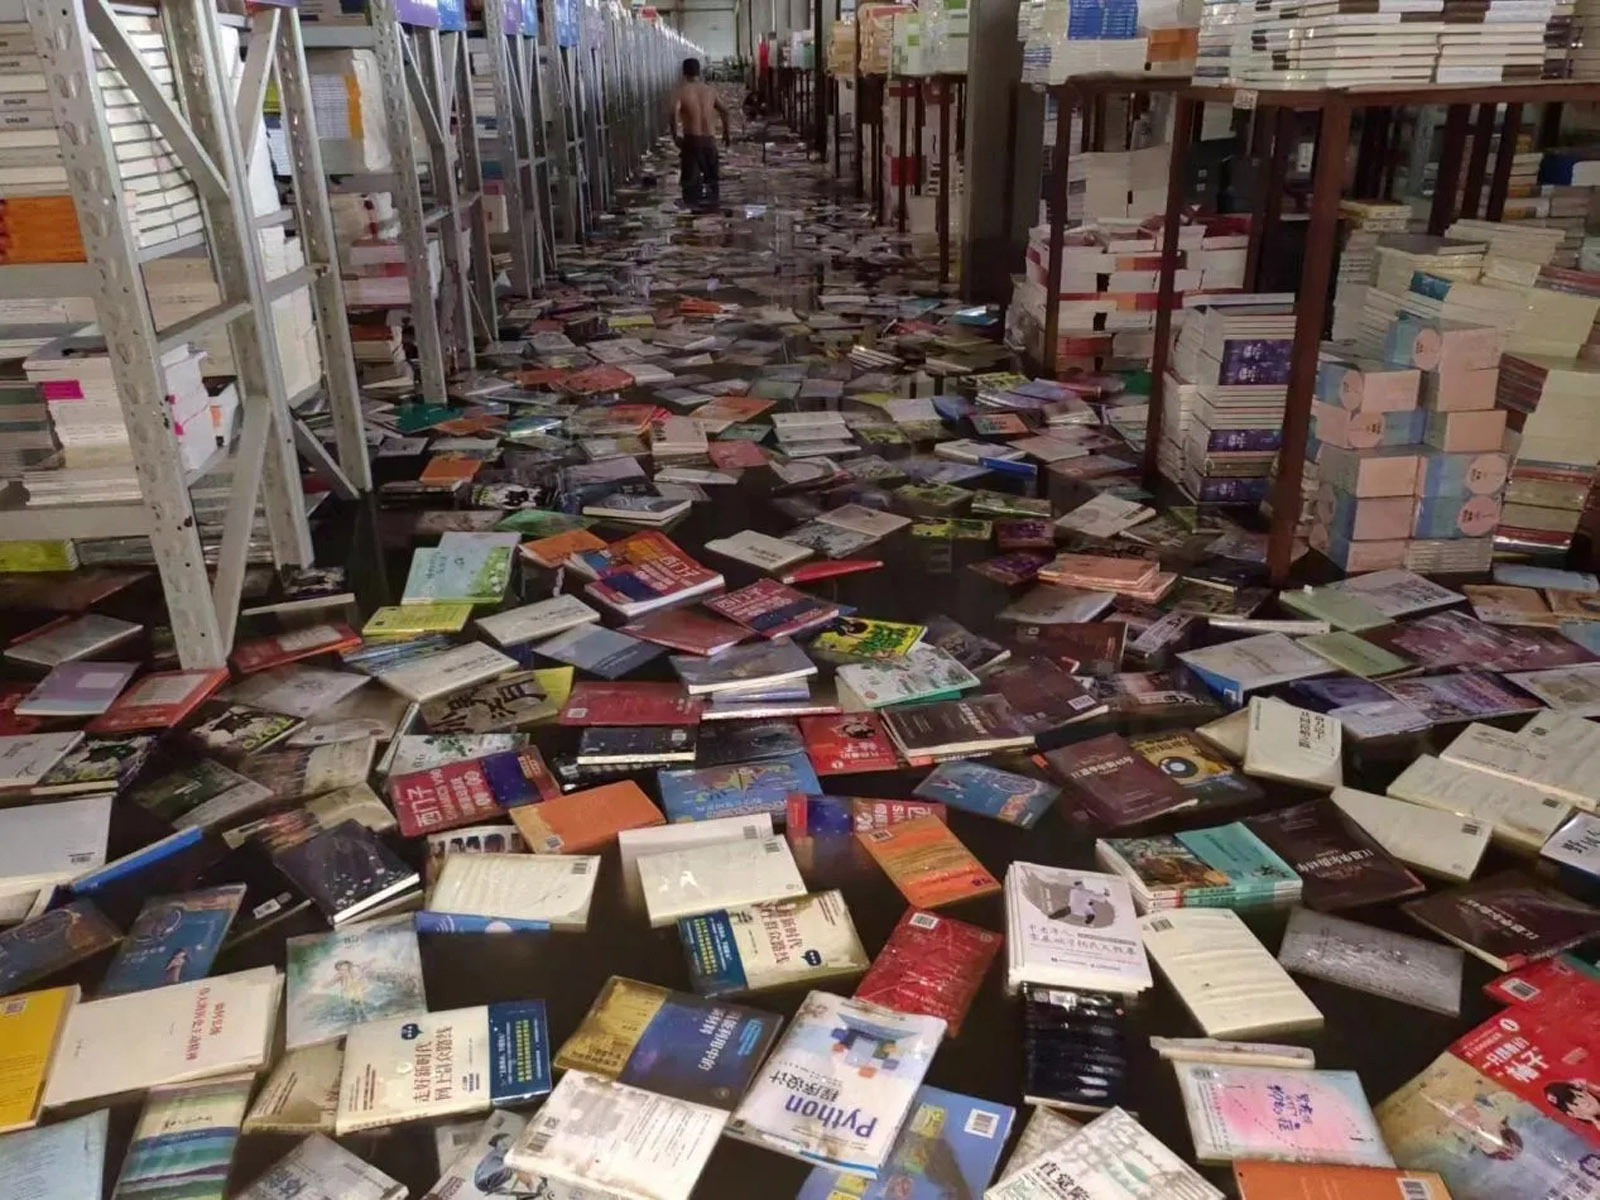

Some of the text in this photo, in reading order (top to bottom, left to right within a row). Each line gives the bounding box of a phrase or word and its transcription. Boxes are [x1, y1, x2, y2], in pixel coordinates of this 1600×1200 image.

[405, 786, 442, 828] 西门子
[768, 1070, 840, 1104] 程序设计
[784, 1093, 878, 1140] Python
